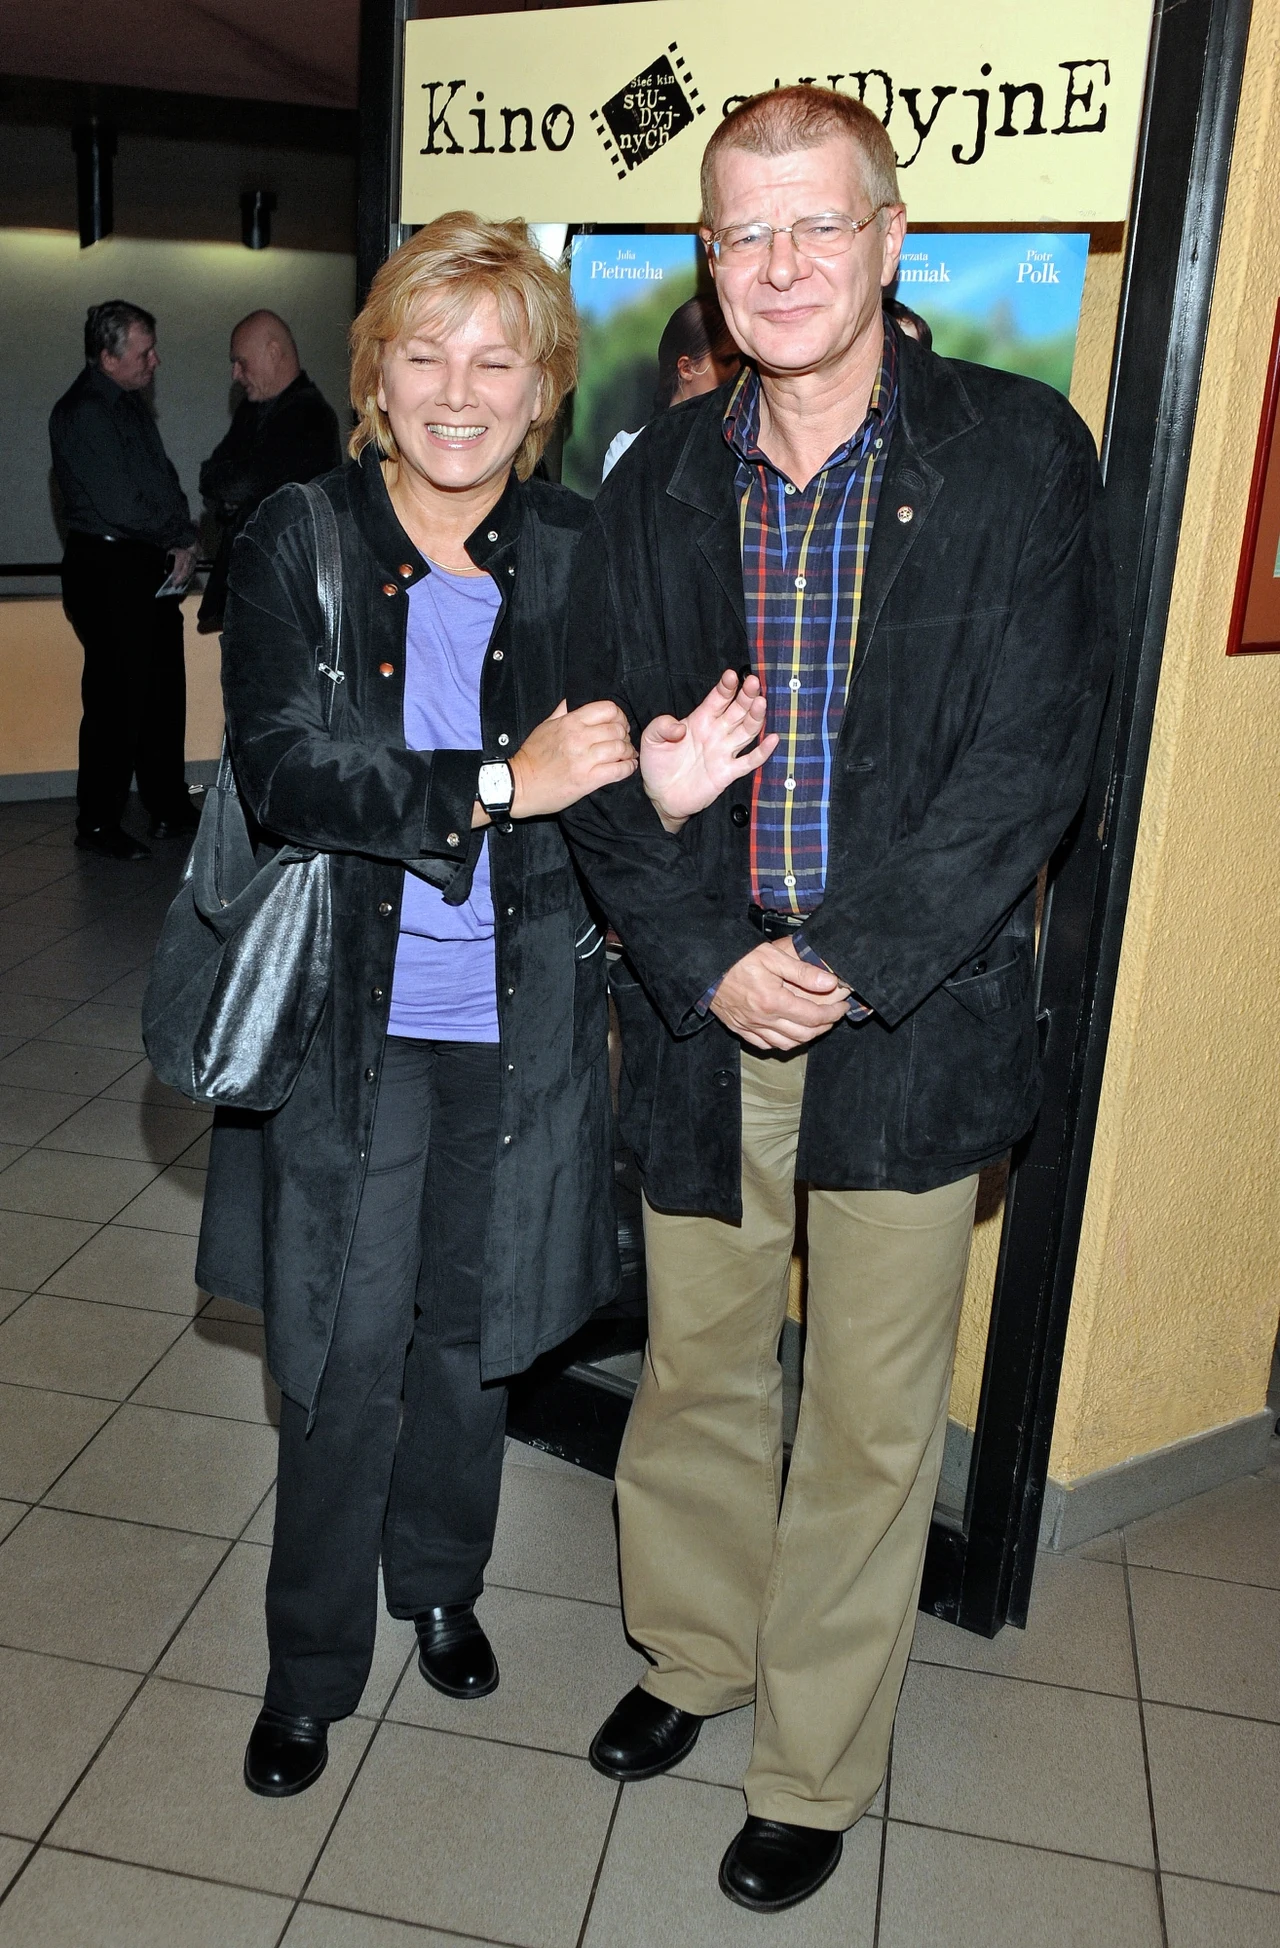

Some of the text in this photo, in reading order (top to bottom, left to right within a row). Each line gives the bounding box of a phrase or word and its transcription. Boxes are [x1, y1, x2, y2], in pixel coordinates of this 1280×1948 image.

[656, 74, 676, 86] kin
[623, 88, 667, 110] stU-
[419, 59, 1111, 169] Kino DyjnE
[639, 105, 681, 130] Dyj-
[619, 127, 670, 154] nyCh
[616, 250, 636, 261] Julia
[899, 252, 929, 261] orzata
[1026, 250, 1053, 261] Piotr
[591, 261, 664, 280] Pietrucha
[897, 262, 952, 283] mniak
[1016, 263, 1062, 284] Polk
